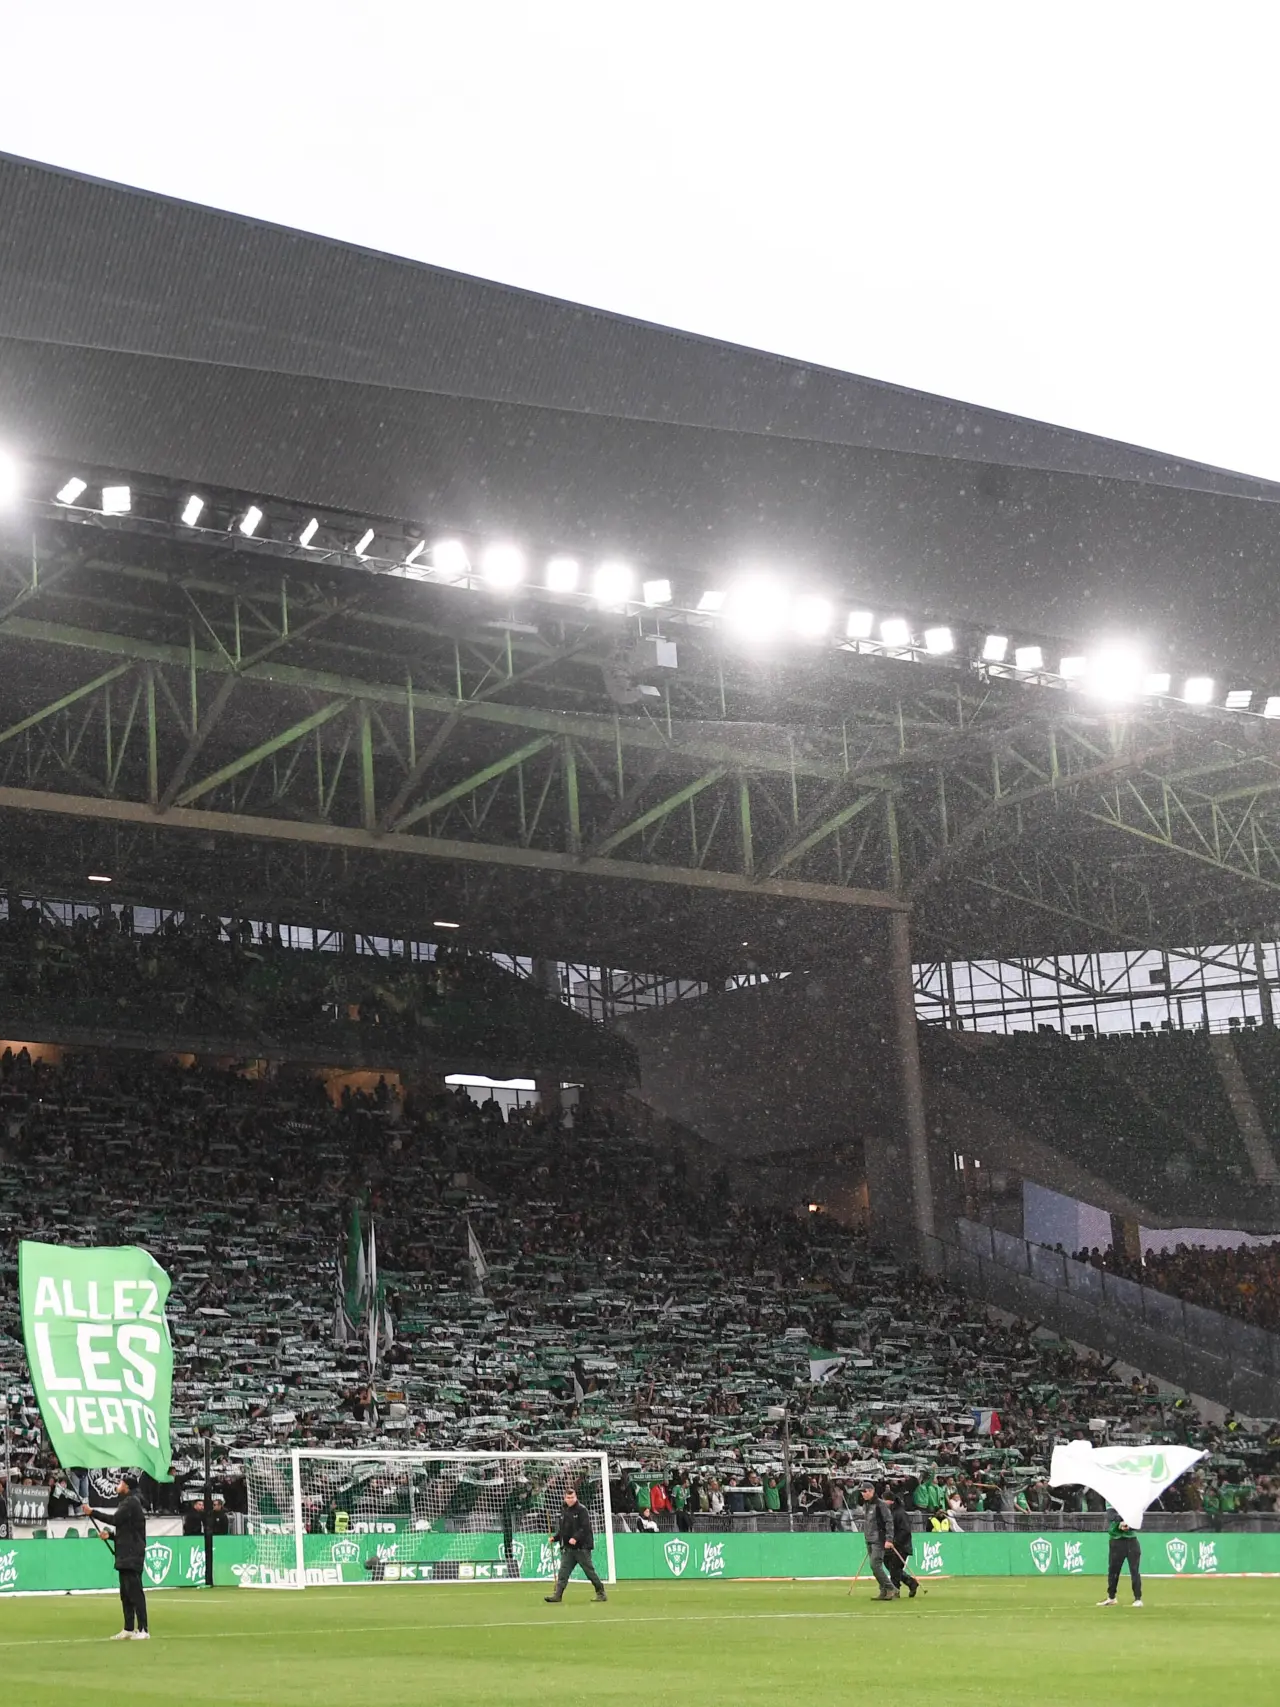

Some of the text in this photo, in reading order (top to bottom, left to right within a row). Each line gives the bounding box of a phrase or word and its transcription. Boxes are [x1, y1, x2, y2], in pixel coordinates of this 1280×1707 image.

[34, 1276, 163, 1323] ALLEZ
[34, 1322, 160, 1401] LES
[48, 1397, 160, 1449] VERTS
[704, 1541, 725, 1560] Vert
[923, 1541, 942, 1557] Vert
[1064, 1541, 1082, 1556] Vert
[384, 1565, 432, 1578] BKT
[459, 1564, 507, 1578] BKT
